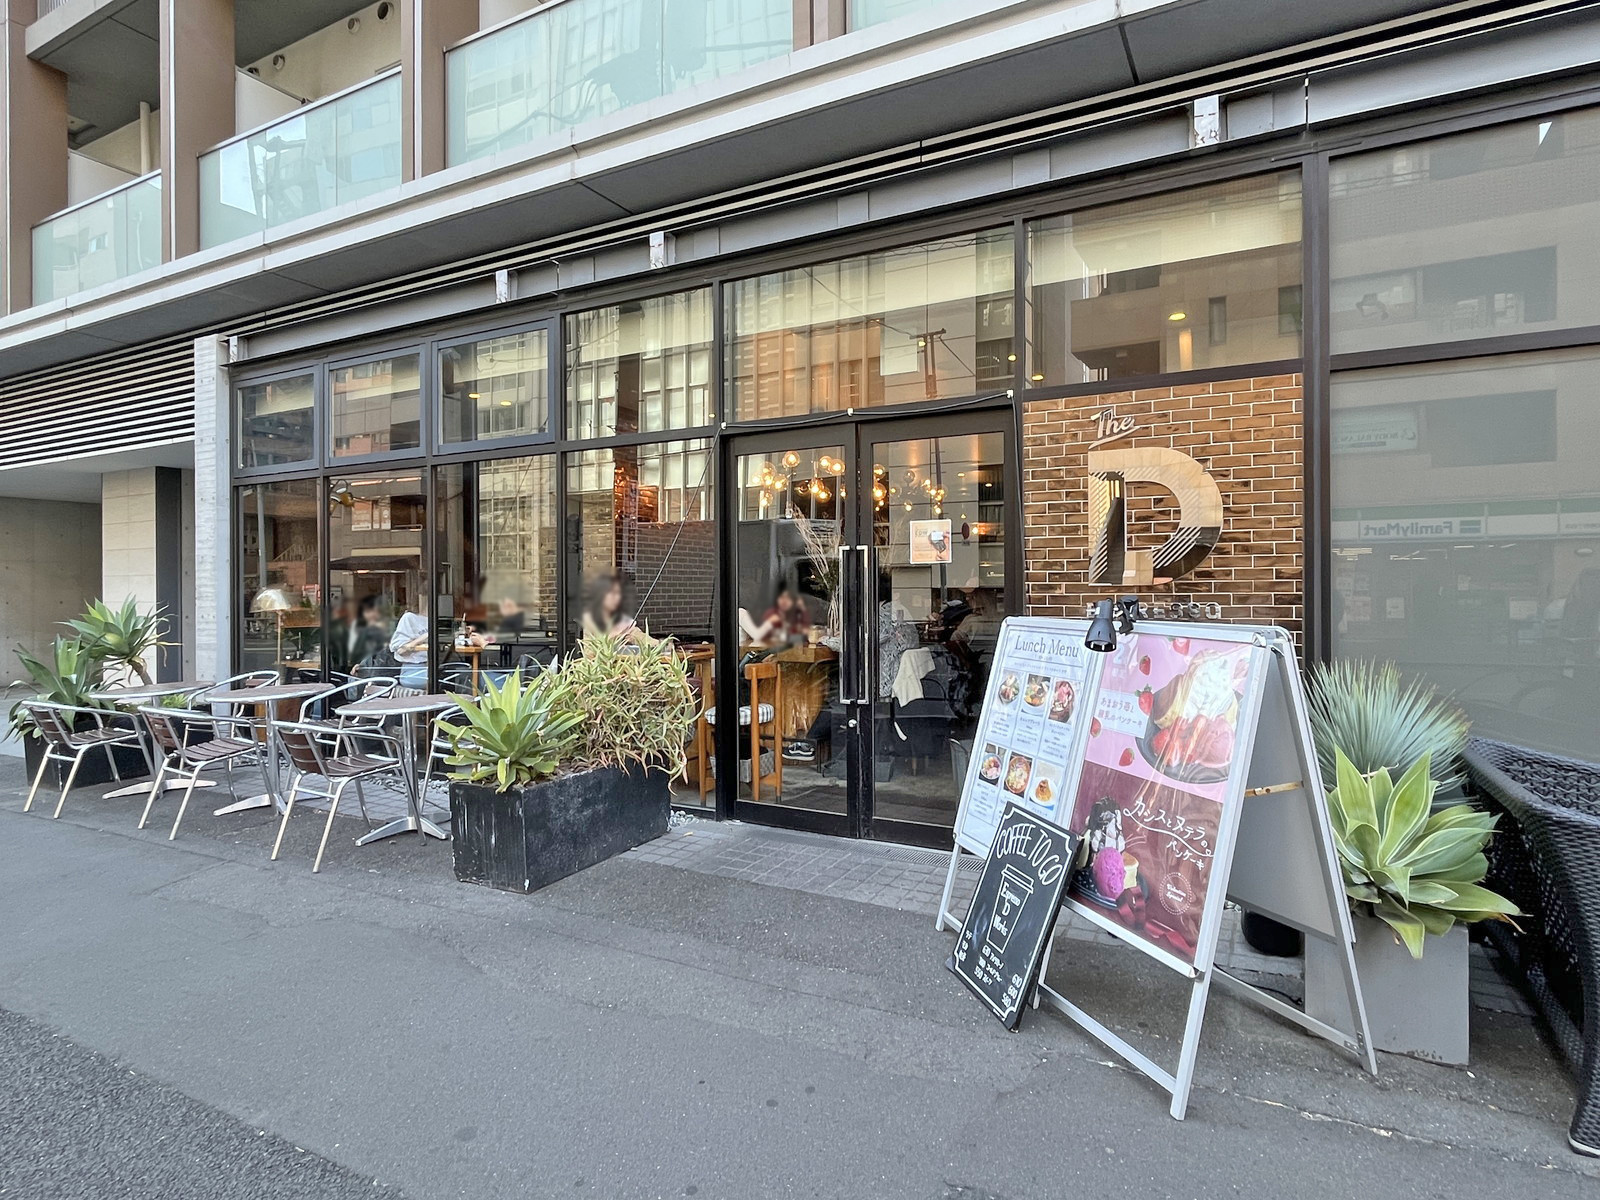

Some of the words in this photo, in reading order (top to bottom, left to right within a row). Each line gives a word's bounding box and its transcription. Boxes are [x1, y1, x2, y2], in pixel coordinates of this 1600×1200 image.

[1089, 408, 1137, 442] The
[1087, 446, 1223, 585] D
[1015, 635, 1046, 654] Lunch
[1047, 638, 1079, 658] Menu
[1133, 796, 1209, 848] カシスとヌテラの
[996, 822, 1036, 859] COFFEE
[1027, 829, 1052, 867] TO
[1166, 840, 1205, 871] パンケーキ
[1037, 854, 1063, 886] GO
